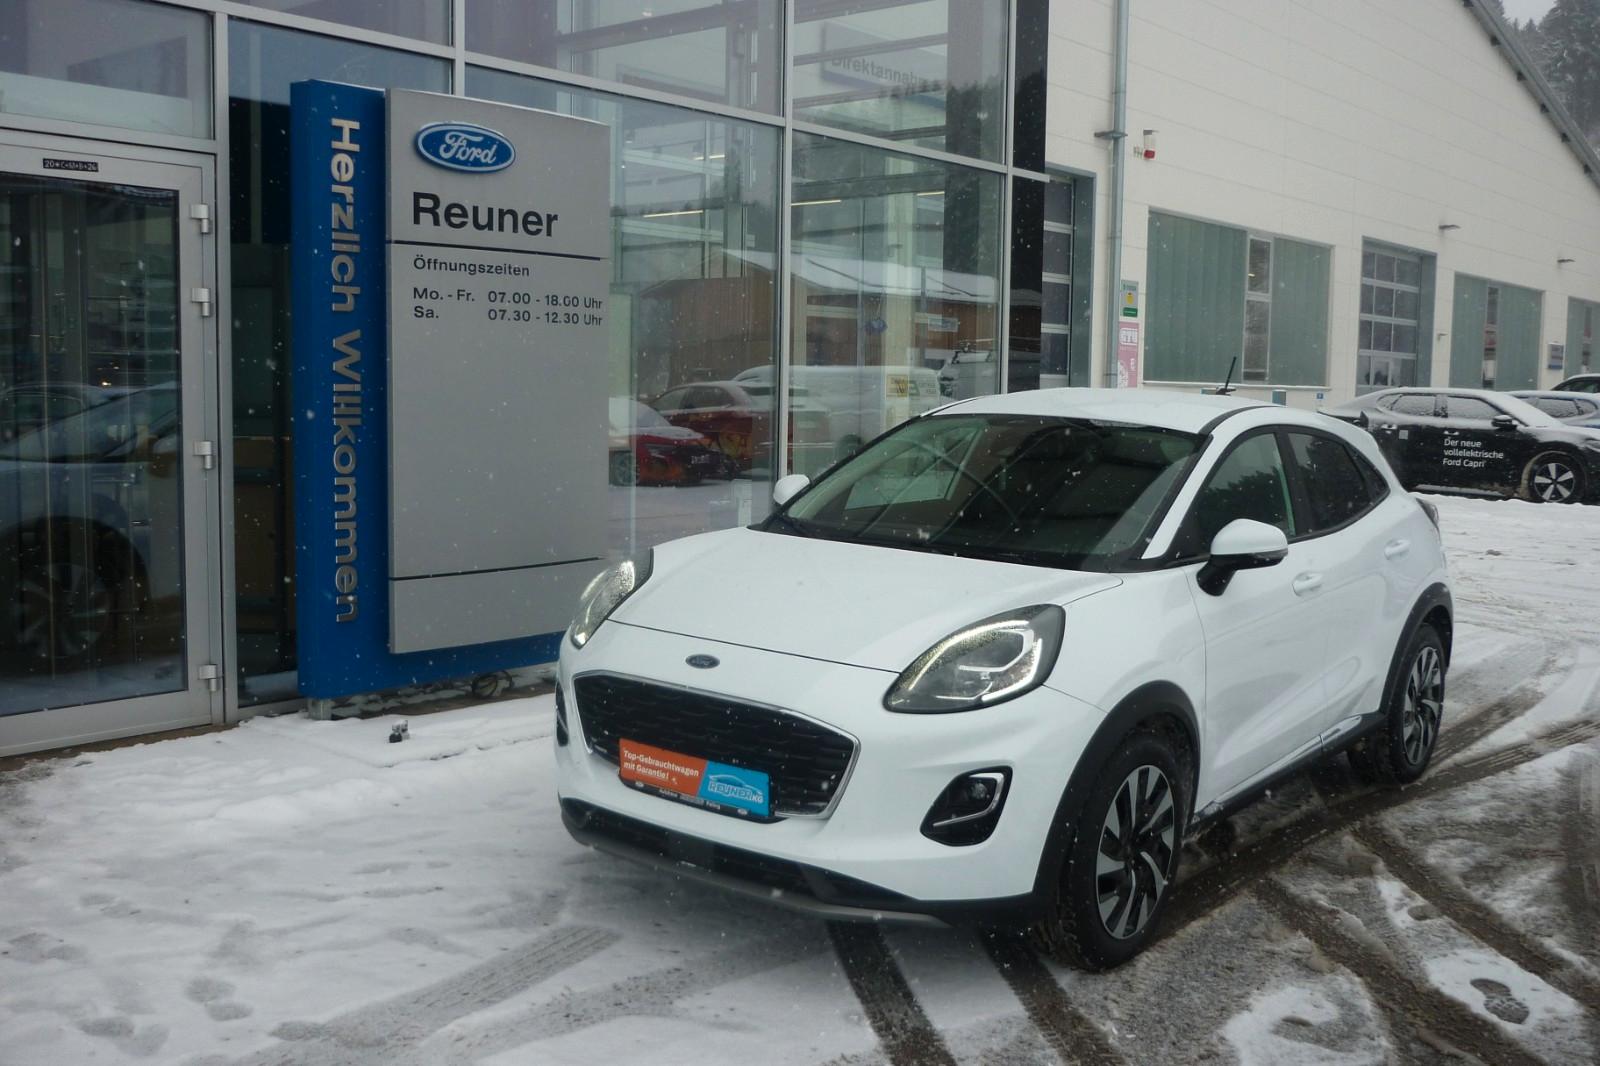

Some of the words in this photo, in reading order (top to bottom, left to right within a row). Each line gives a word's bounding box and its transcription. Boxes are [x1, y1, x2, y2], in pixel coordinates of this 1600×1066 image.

[439, 130, 499, 164] Ford
[330, 117, 361, 313] Herzlich
[413, 191, 559, 237] Reuner
[413, 254, 530, 277] Öffnungszeiten
[413, 287, 444, 301] Mo.
[456, 289, 476, 302] Fr.
[488, 290, 531, 305] 07.00
[545, 295, 580, 308] 18.00
[584, 297, 603, 310] Uhr
[413, 306, 440, 319] Sa.
[488, 309, 531, 322] 07.30
[545, 312, 580, 325] 12.30
[584, 314, 603, 327] Uhr
[1443, 438, 1459, 447] Der
[1460, 440, 1482, 448] neue
[1443, 449, 1504, 459] vollelektrische
[1442, 458, 1462, 467] Ford
[1463, 459, 1485, 468] Capri
[332, 329, 362, 623] Willkommen
[623, 750, 699, 777] Top-Gebrauchtwagen
[623, 762, 636, 771] mit
[636, 764, 670, 780] Garantie!
